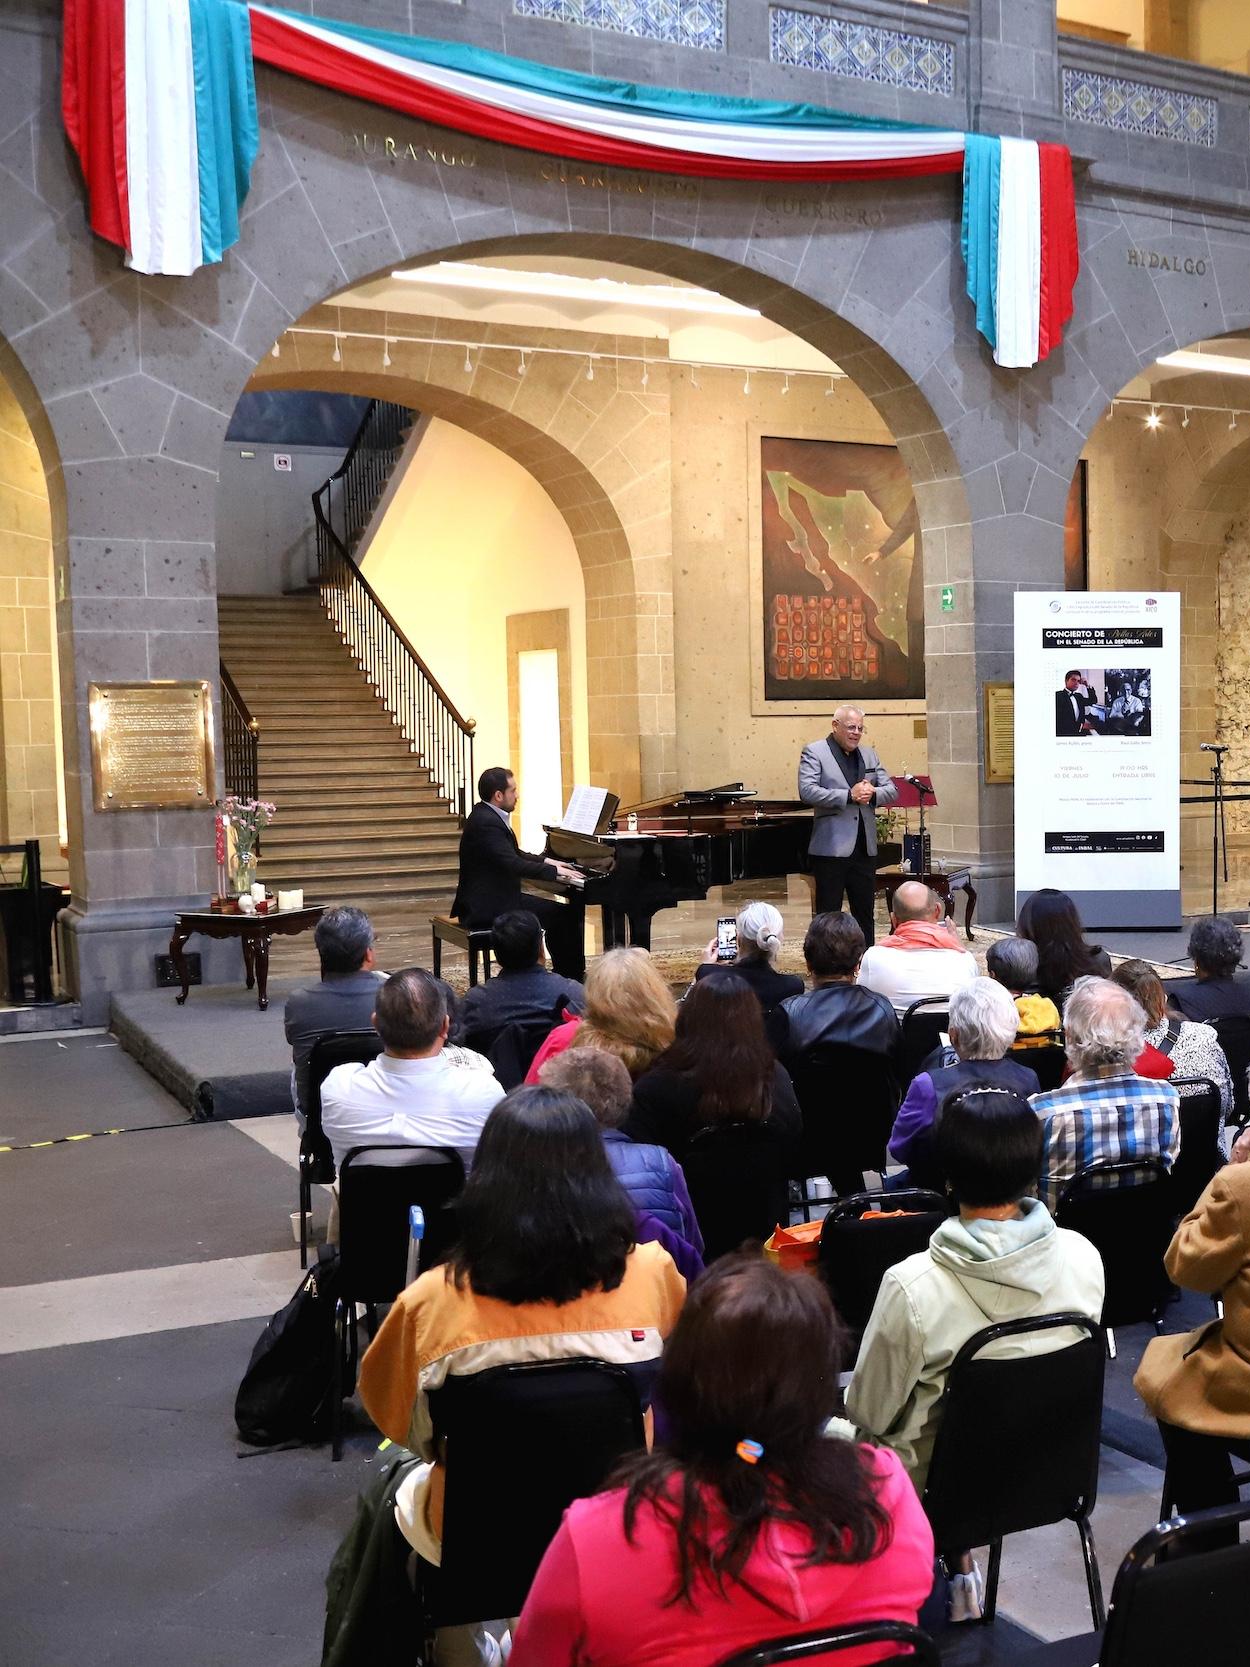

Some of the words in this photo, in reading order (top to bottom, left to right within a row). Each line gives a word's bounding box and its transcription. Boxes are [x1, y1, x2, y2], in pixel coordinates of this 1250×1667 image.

[765, 194, 882, 227] GUERRERO
[1127, 248, 1207, 276] HIDALGO
[1045, 630, 1092, 638] CONCIERTO
[1094, 630, 1105, 638] DE
[1114, 637, 1144, 645] REPÚBLICA
